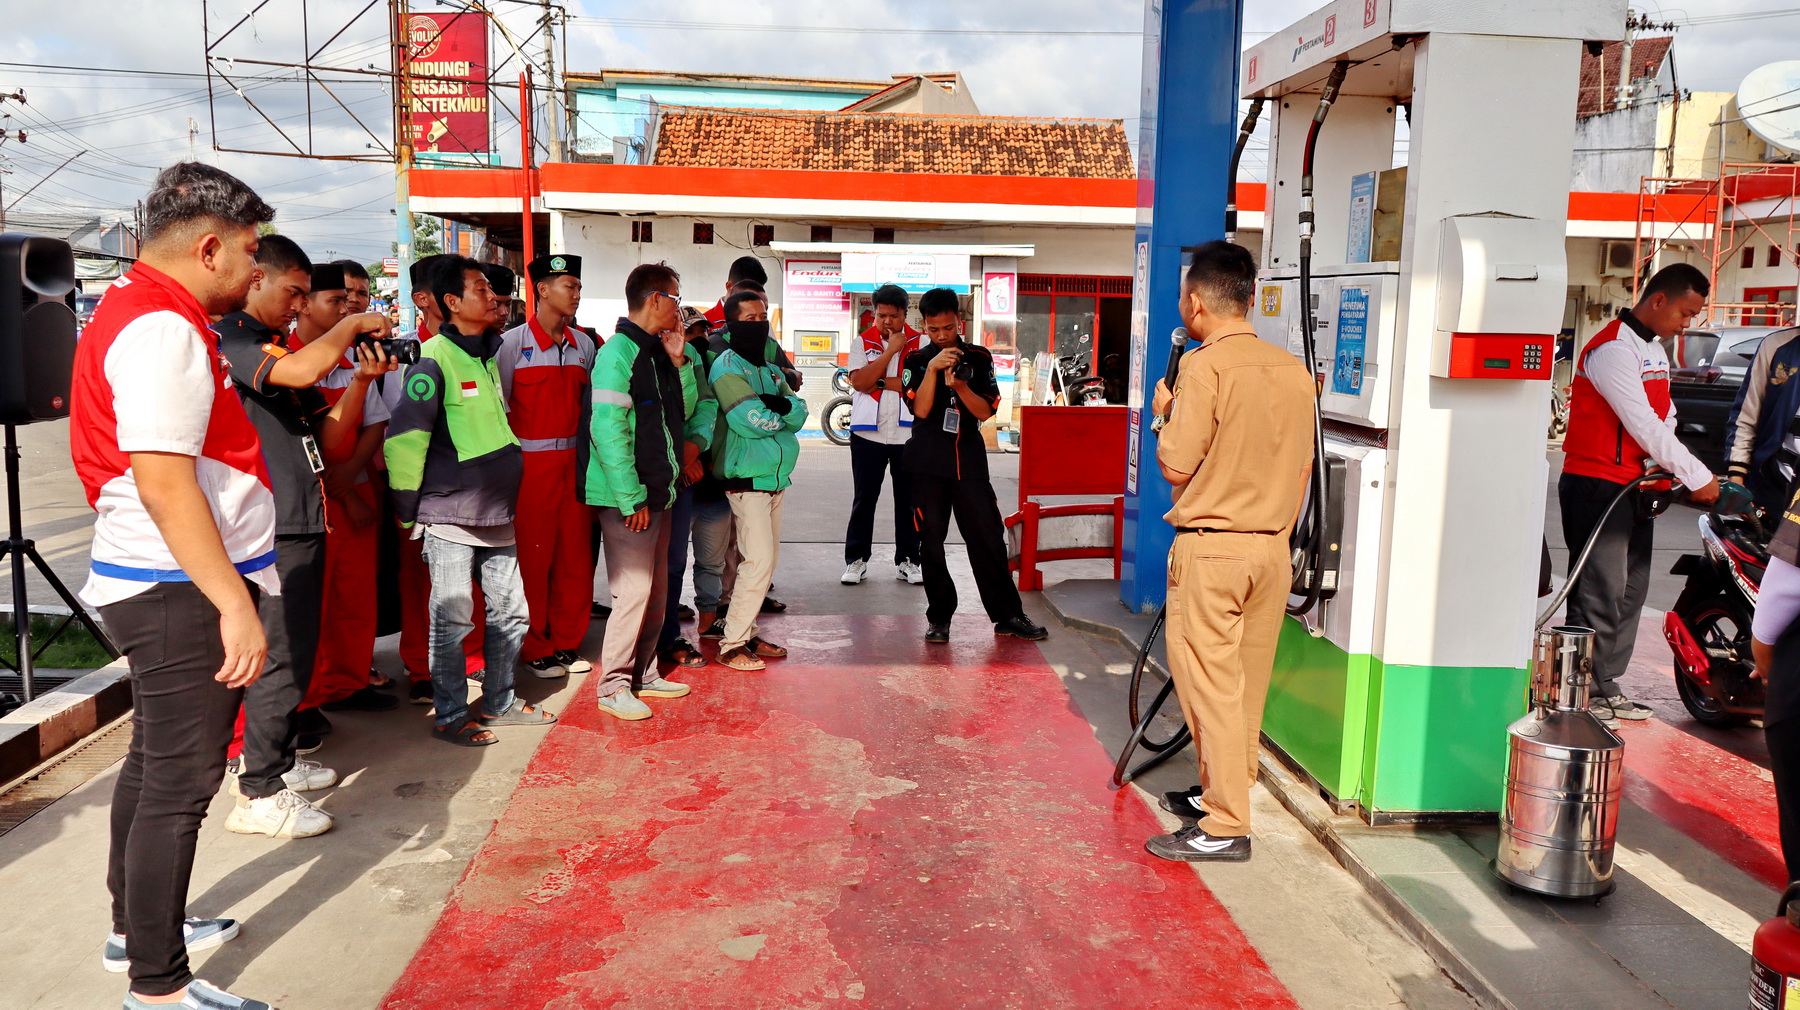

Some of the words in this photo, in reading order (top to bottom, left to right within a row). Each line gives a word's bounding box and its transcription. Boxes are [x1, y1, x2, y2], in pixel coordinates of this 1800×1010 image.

[1326, 18, 1334, 44] 2
[1302, 34, 1324, 53] PERTAMINA
[402, 61, 470, 77] INDUNGI
[746, 409, 780, 431] Grab
